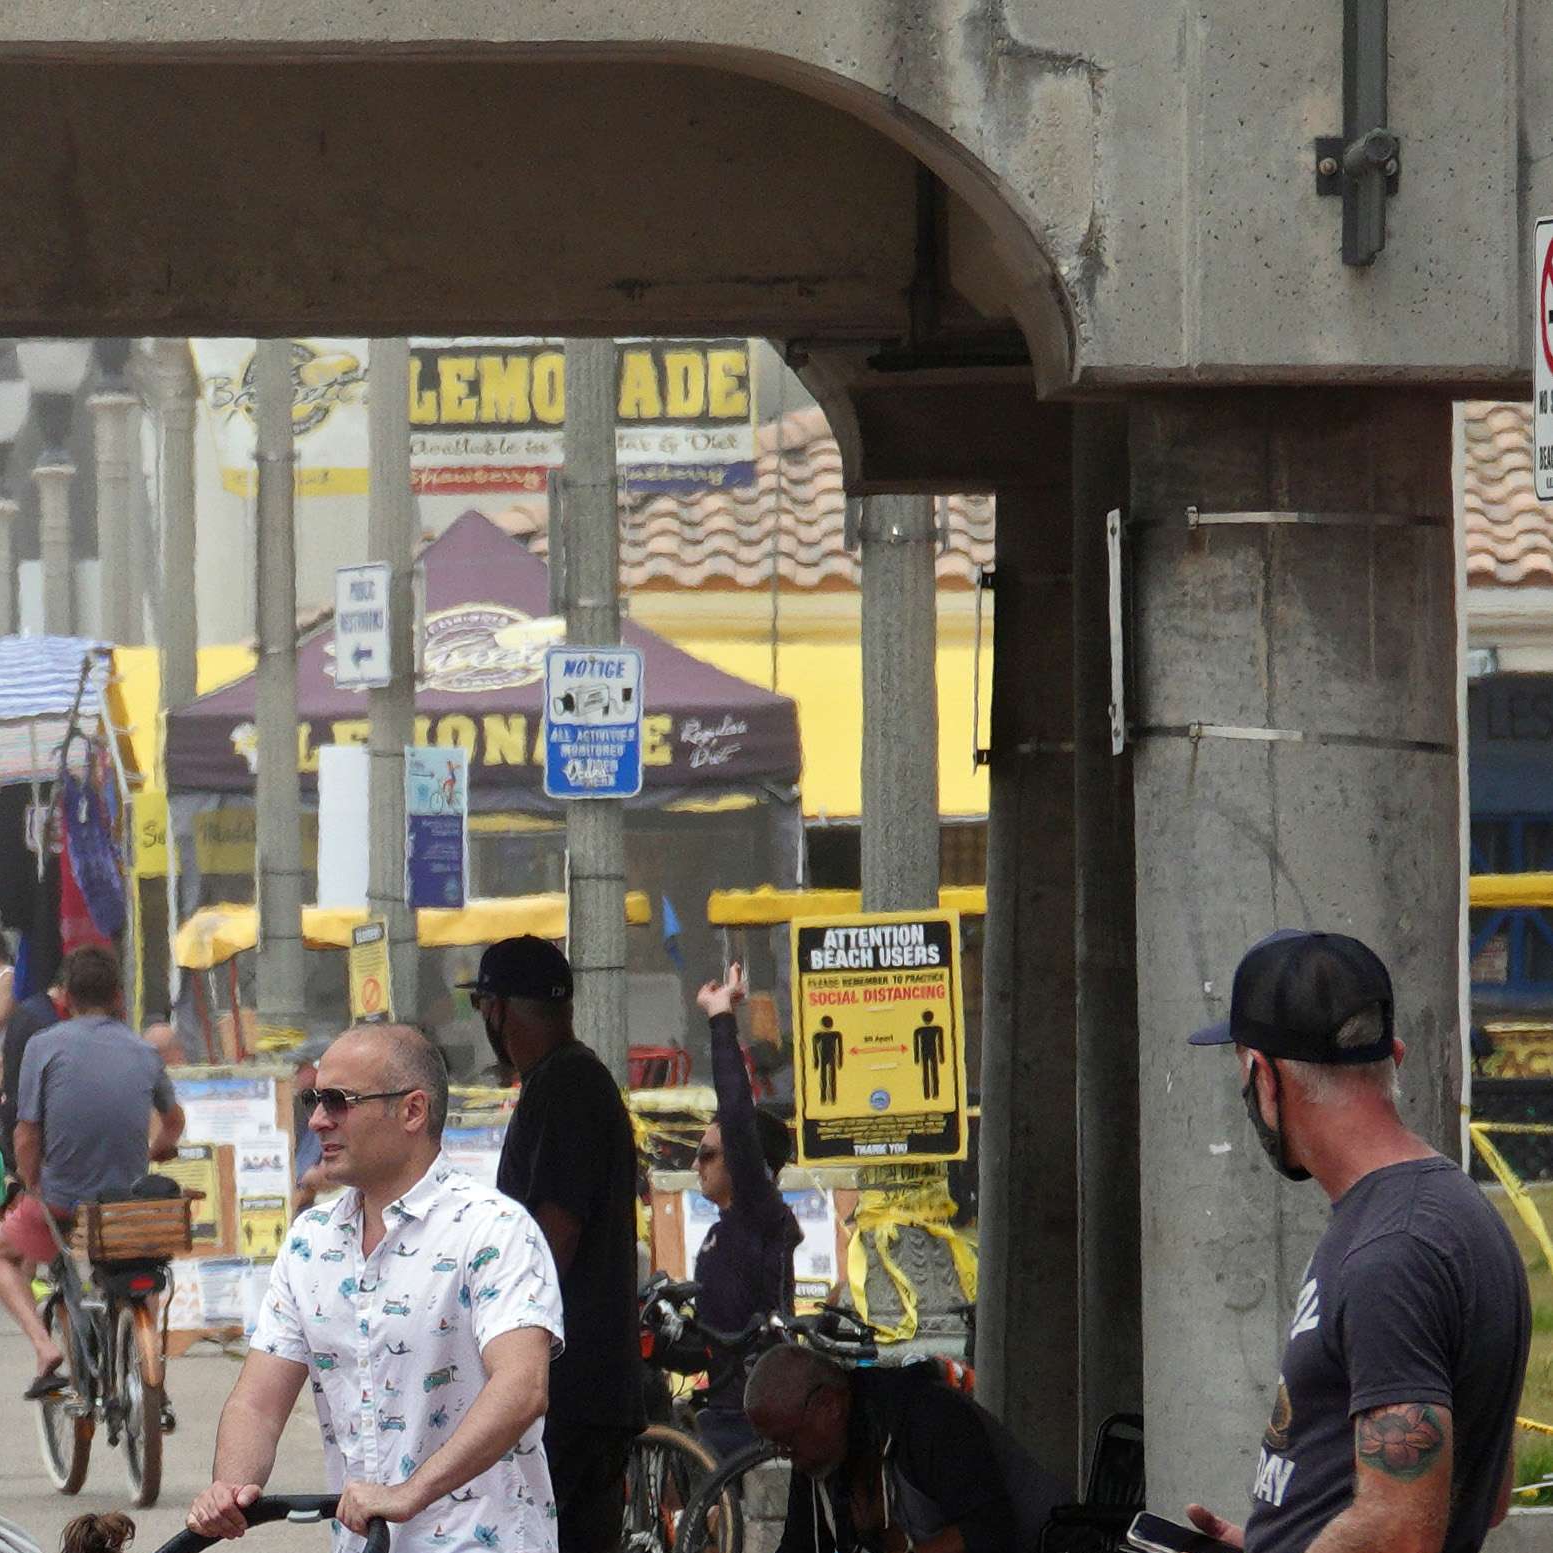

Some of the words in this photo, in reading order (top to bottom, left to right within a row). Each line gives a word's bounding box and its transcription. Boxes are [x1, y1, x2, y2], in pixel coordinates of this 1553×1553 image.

[408, 350, 750, 424] LEMOADE
[563, 659, 626, 679] NOTICE
[823, 924, 925, 949] ATTENTION
[810, 947, 874, 970] BEACH
[879, 943, 941, 968] USERS
[842, 974, 889, 988] REMEMBER
[892, 973, 904, 985] TO
[809, 989, 859, 1006] SOCIAL
[862, 983, 946, 1004] DISTANCING
[853, 1143, 887, 1156] THANK
[888, 1142, 908, 1155] YOU
